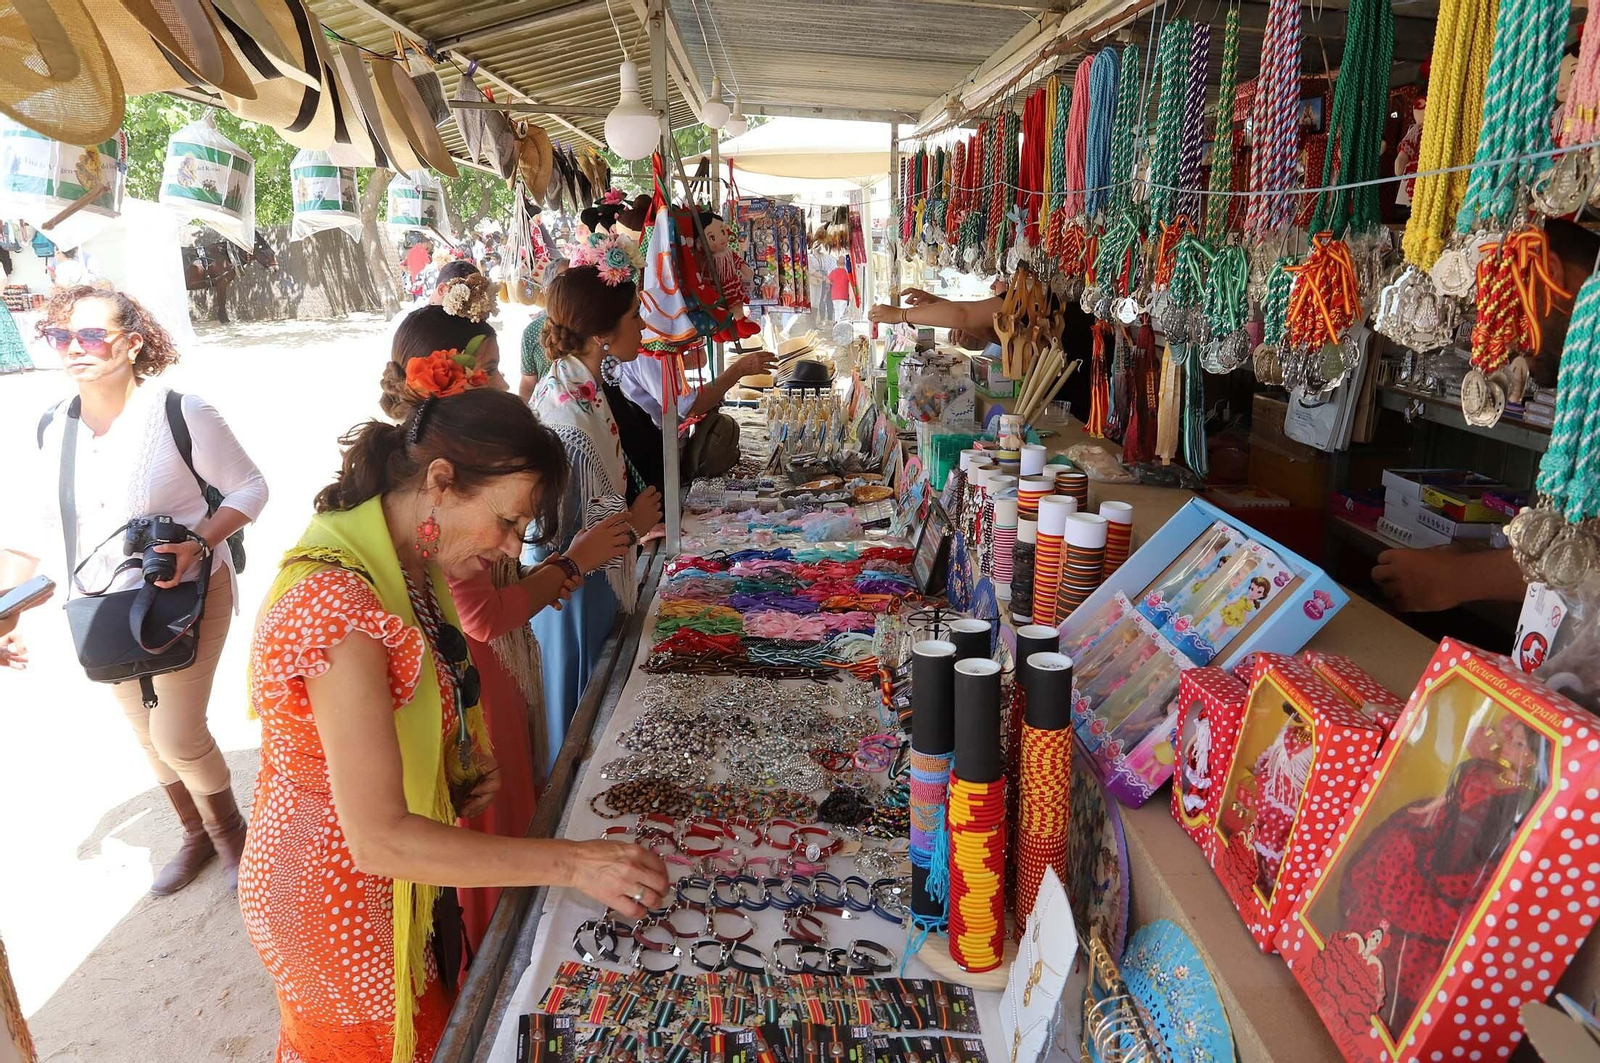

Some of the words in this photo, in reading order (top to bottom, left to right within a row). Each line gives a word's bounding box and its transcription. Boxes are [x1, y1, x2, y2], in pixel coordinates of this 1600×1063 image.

[1466, 658, 1508, 691] Recuerdo
[1506, 686, 1523, 699] de
[1521, 694, 1564, 728] España
